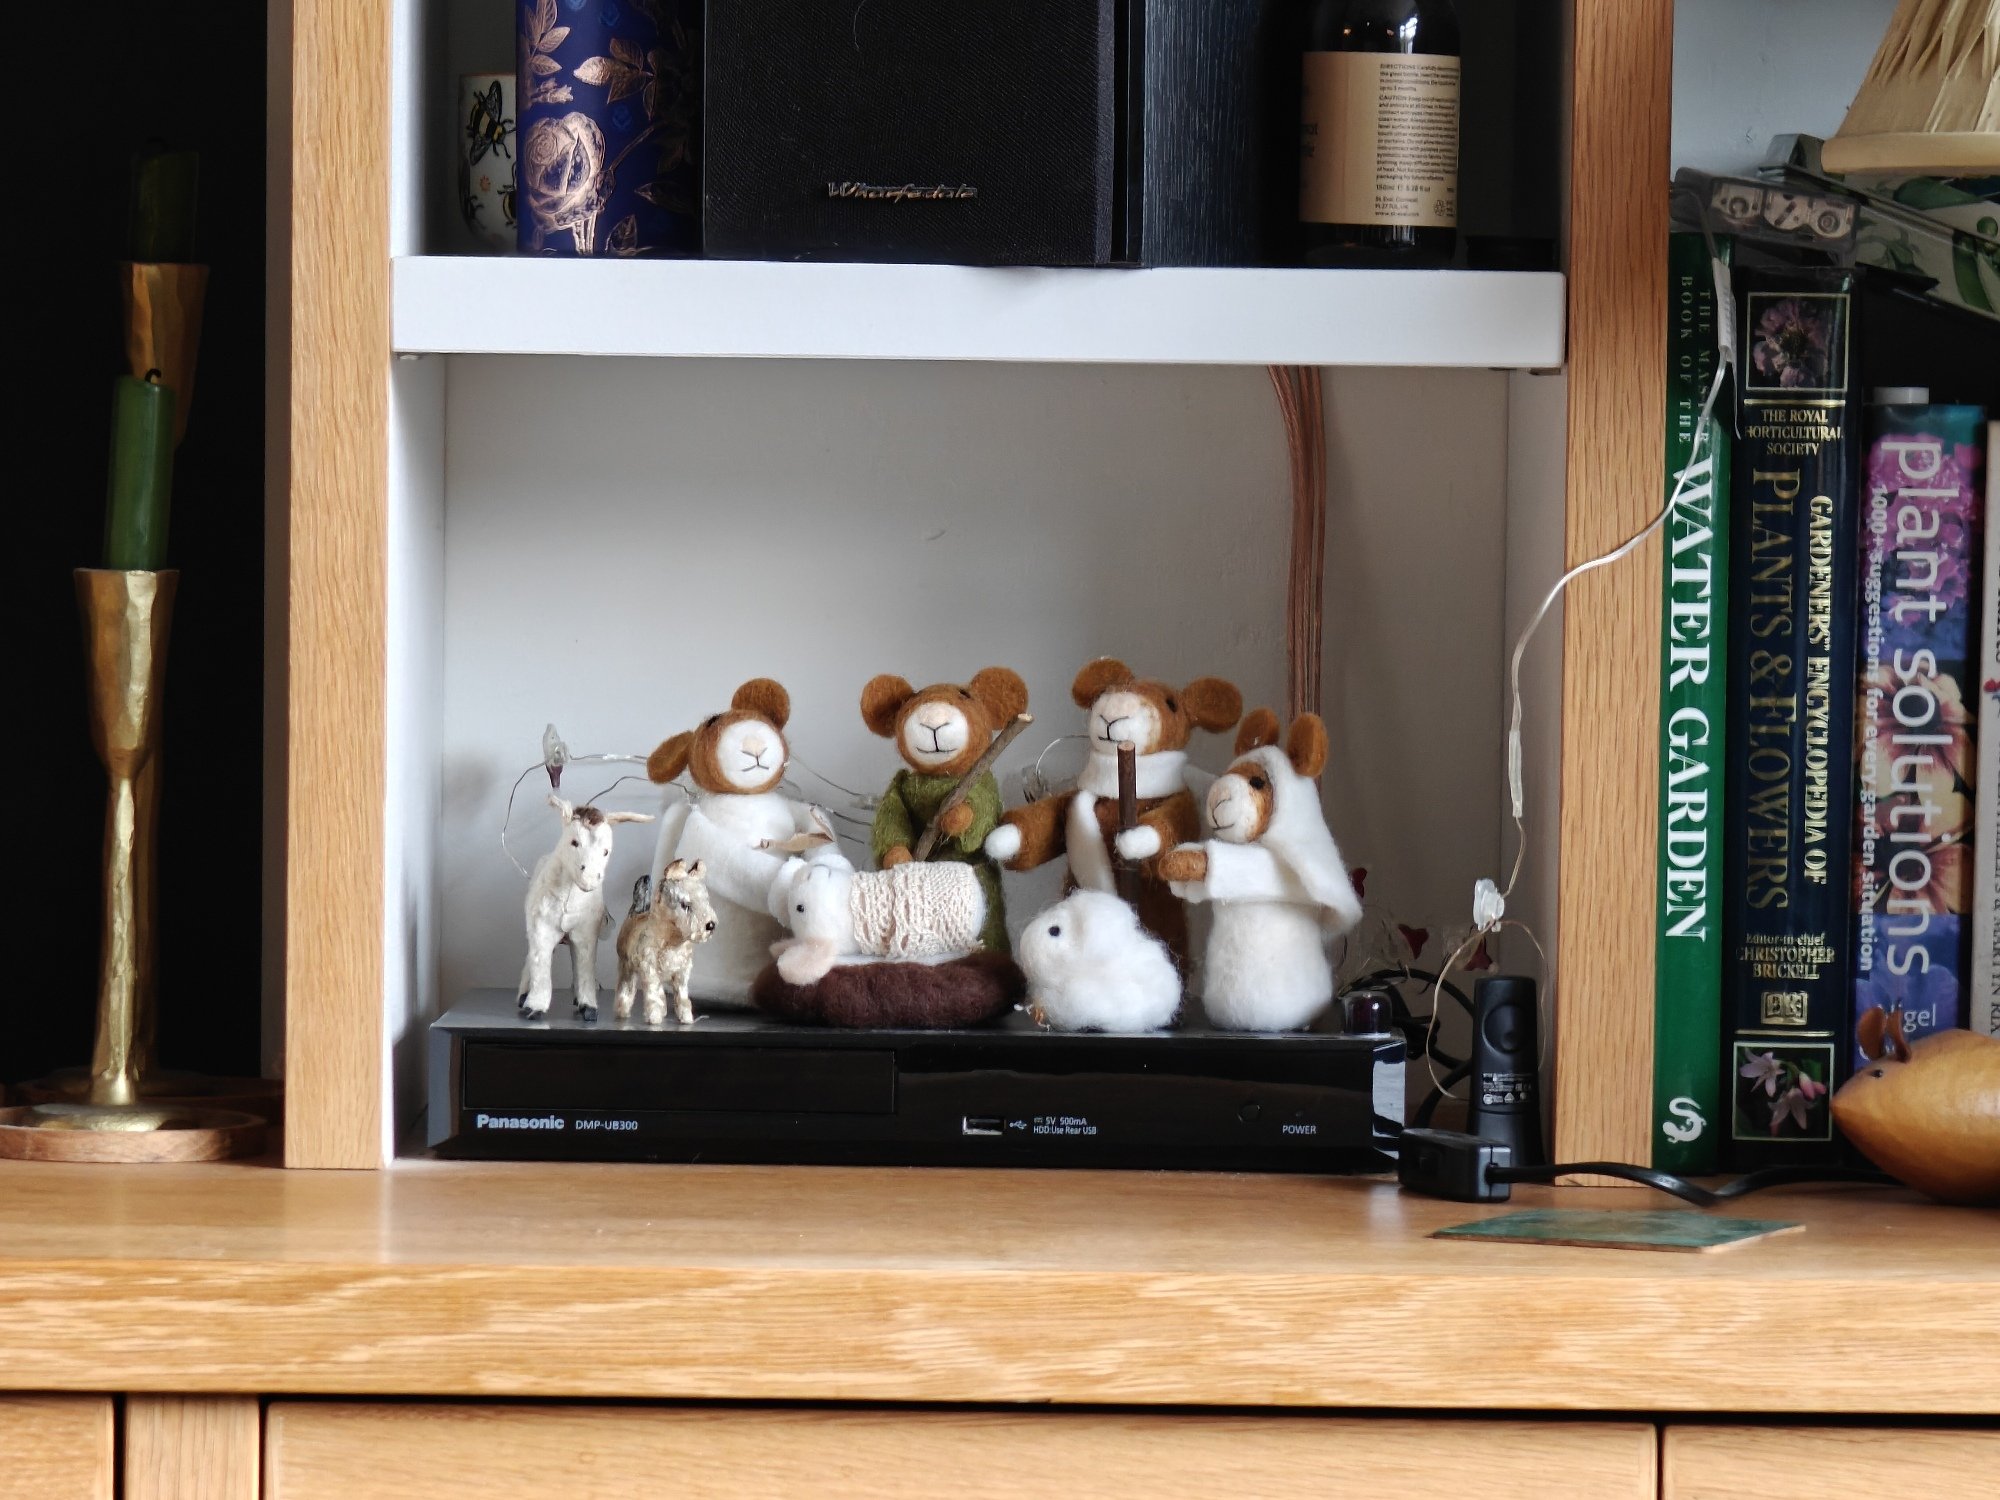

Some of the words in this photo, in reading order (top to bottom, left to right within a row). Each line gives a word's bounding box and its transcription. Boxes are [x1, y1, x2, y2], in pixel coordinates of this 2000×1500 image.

[1679, 275, 1694, 339] BOOK
[1697, 289, 1712, 335] THE
[1679, 354, 1693, 385] OF
[1678, 398, 1692, 444] THE
[1745, 425, 1844, 442] HORTICULTURAL
[1761, 409, 1787, 423] THE
[1789, 409, 1829, 424] ROYAL
[1766, 442, 1820, 456] SOCIETY
[1869, 484, 1889, 545] 1000+
[1880, 441, 1960, 623] plant
[1669, 455, 1714, 693] WATER
[1749, 467, 1801, 639] PLANTS
[1865, 549, 1885, 683] suggestions
[1749, 649, 1793, 685] &
[1866, 688, 1884, 720] for
[1804, 656, 1831, 844] ENCYCLOPEDIA
[1861, 724, 1879, 784] every
[1746, 692, 1798, 910] FLOWERS
[1886, 648, 1955, 977] solutions
[1665, 706, 1710, 943] GARDEN
[1860, 790, 1878, 866] garden
[1804, 848, 1829, 886] OF
[1860, 872, 1878, 971] situation
[1735, 945, 1835, 963] CHRISTOPHER
[1752, 962, 1820, 980] BRICKELL
[1877, 1002, 1937, 1033] gel
[476, 1113, 565, 1130] Panasonic
[575, 1120, 638, 1131] DMP-UB300
[1045, 1116, 1057, 1125] 5V
[1060, 1117, 1088, 1126] 500mA
[1065, 1126, 1081, 1135] Rear
[1082, 1126, 1098, 1136] USB
[1282, 1124, 1318, 1135] POWER
